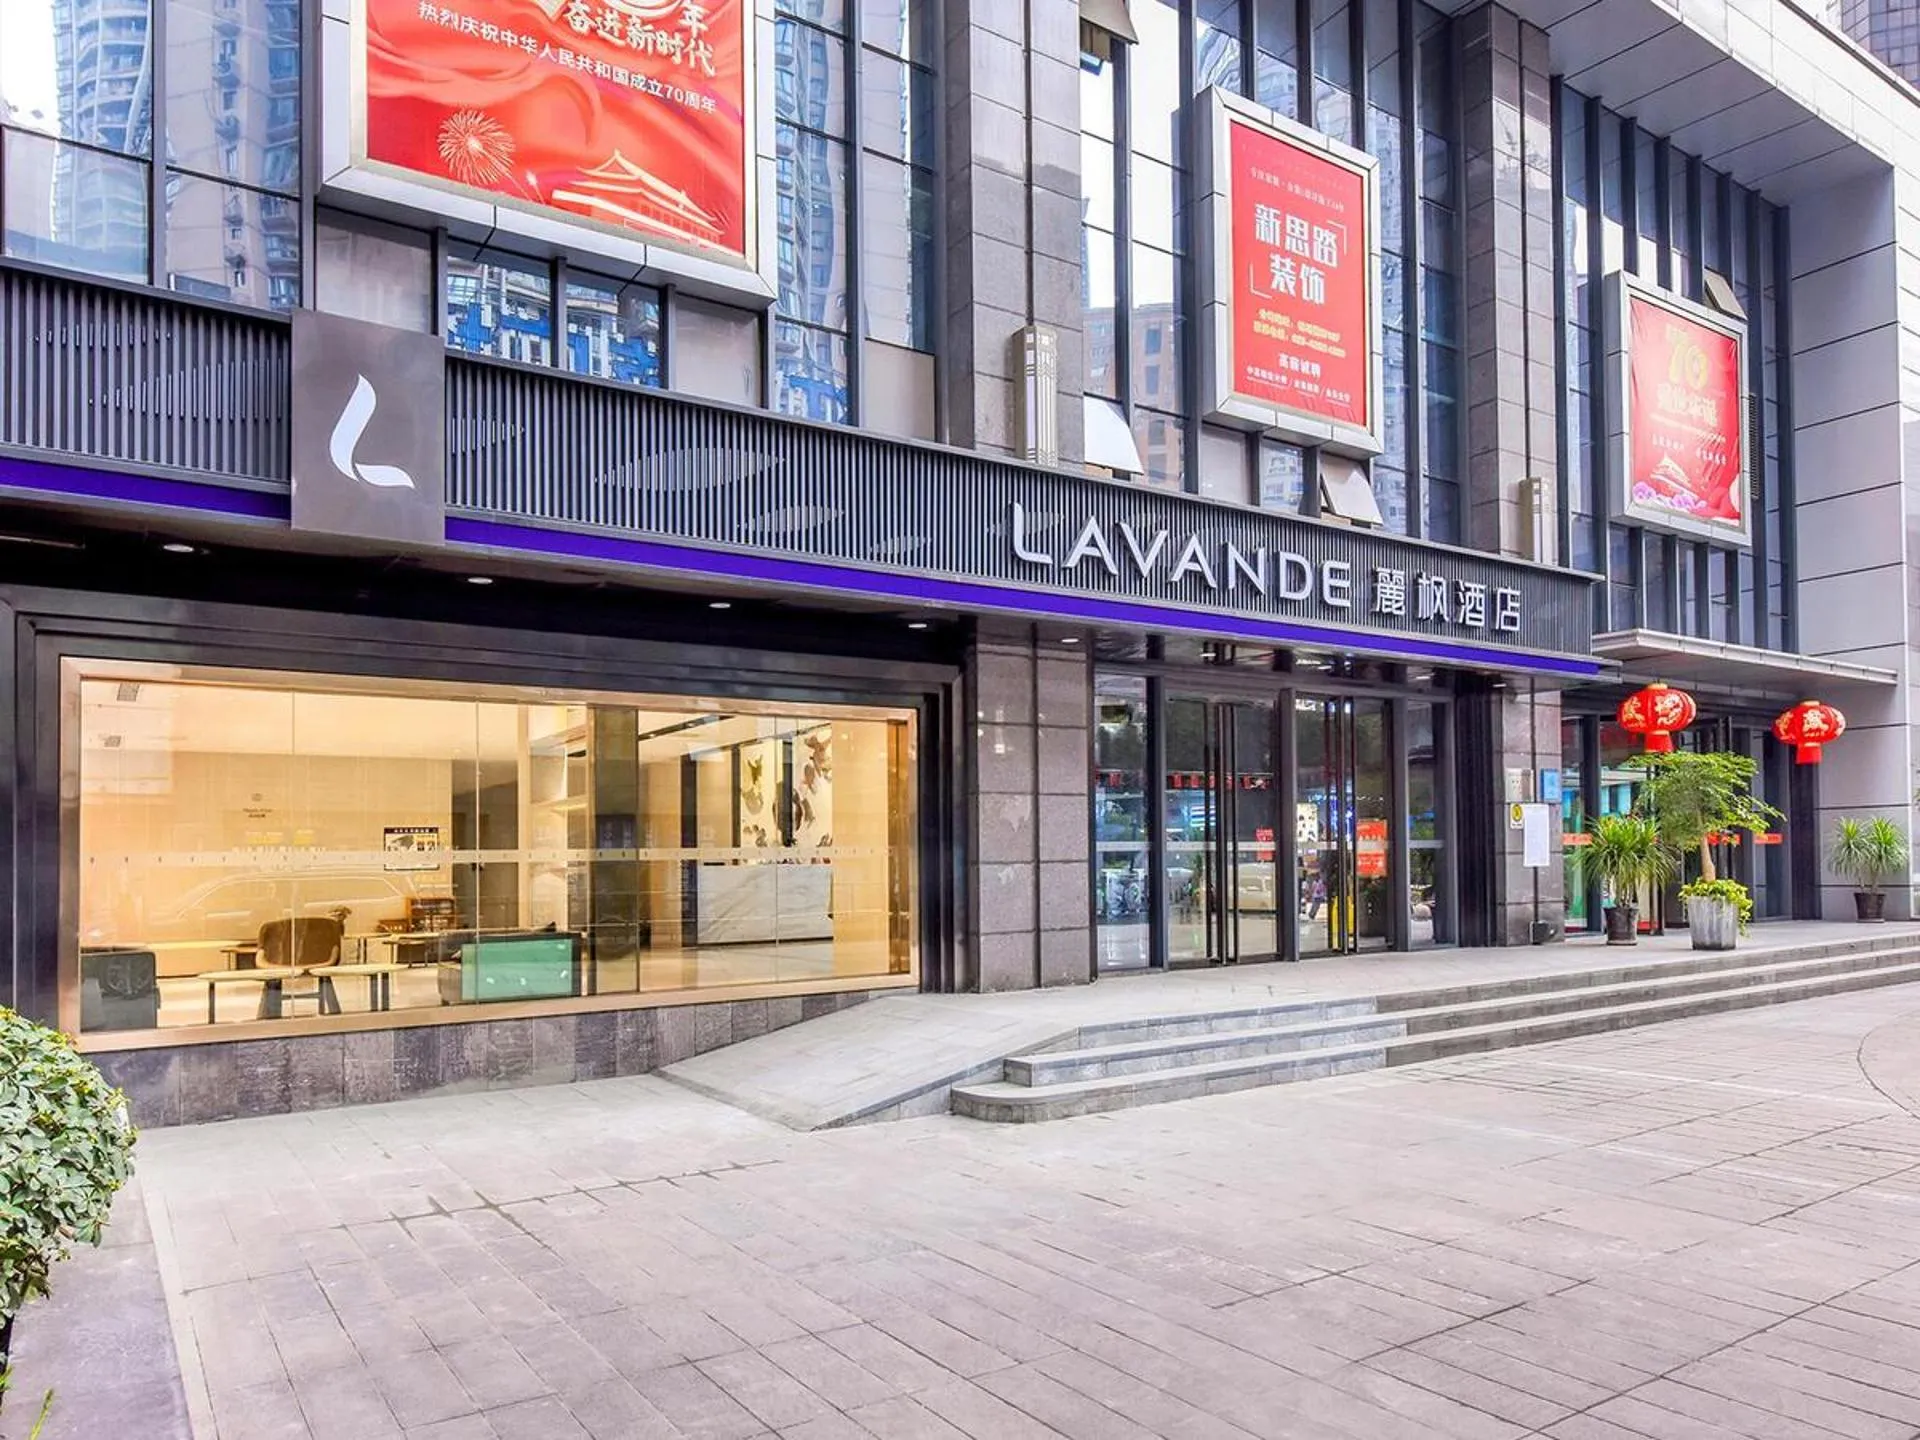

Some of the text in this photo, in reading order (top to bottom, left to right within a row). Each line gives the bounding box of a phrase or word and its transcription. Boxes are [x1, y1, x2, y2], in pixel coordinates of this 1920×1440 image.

[565, 0, 716, 77] 奋进新时代
[679, 0, 709, 38] 年
[417, 2, 718, 114] 热烈庆祝中华人民共和国成立70周年
[1254, 203, 1338, 269] 新思路
[1269, 252, 1325, 304] 装饰
[1009, 501, 1522, 632] LAVANDE 麗枫酒店
